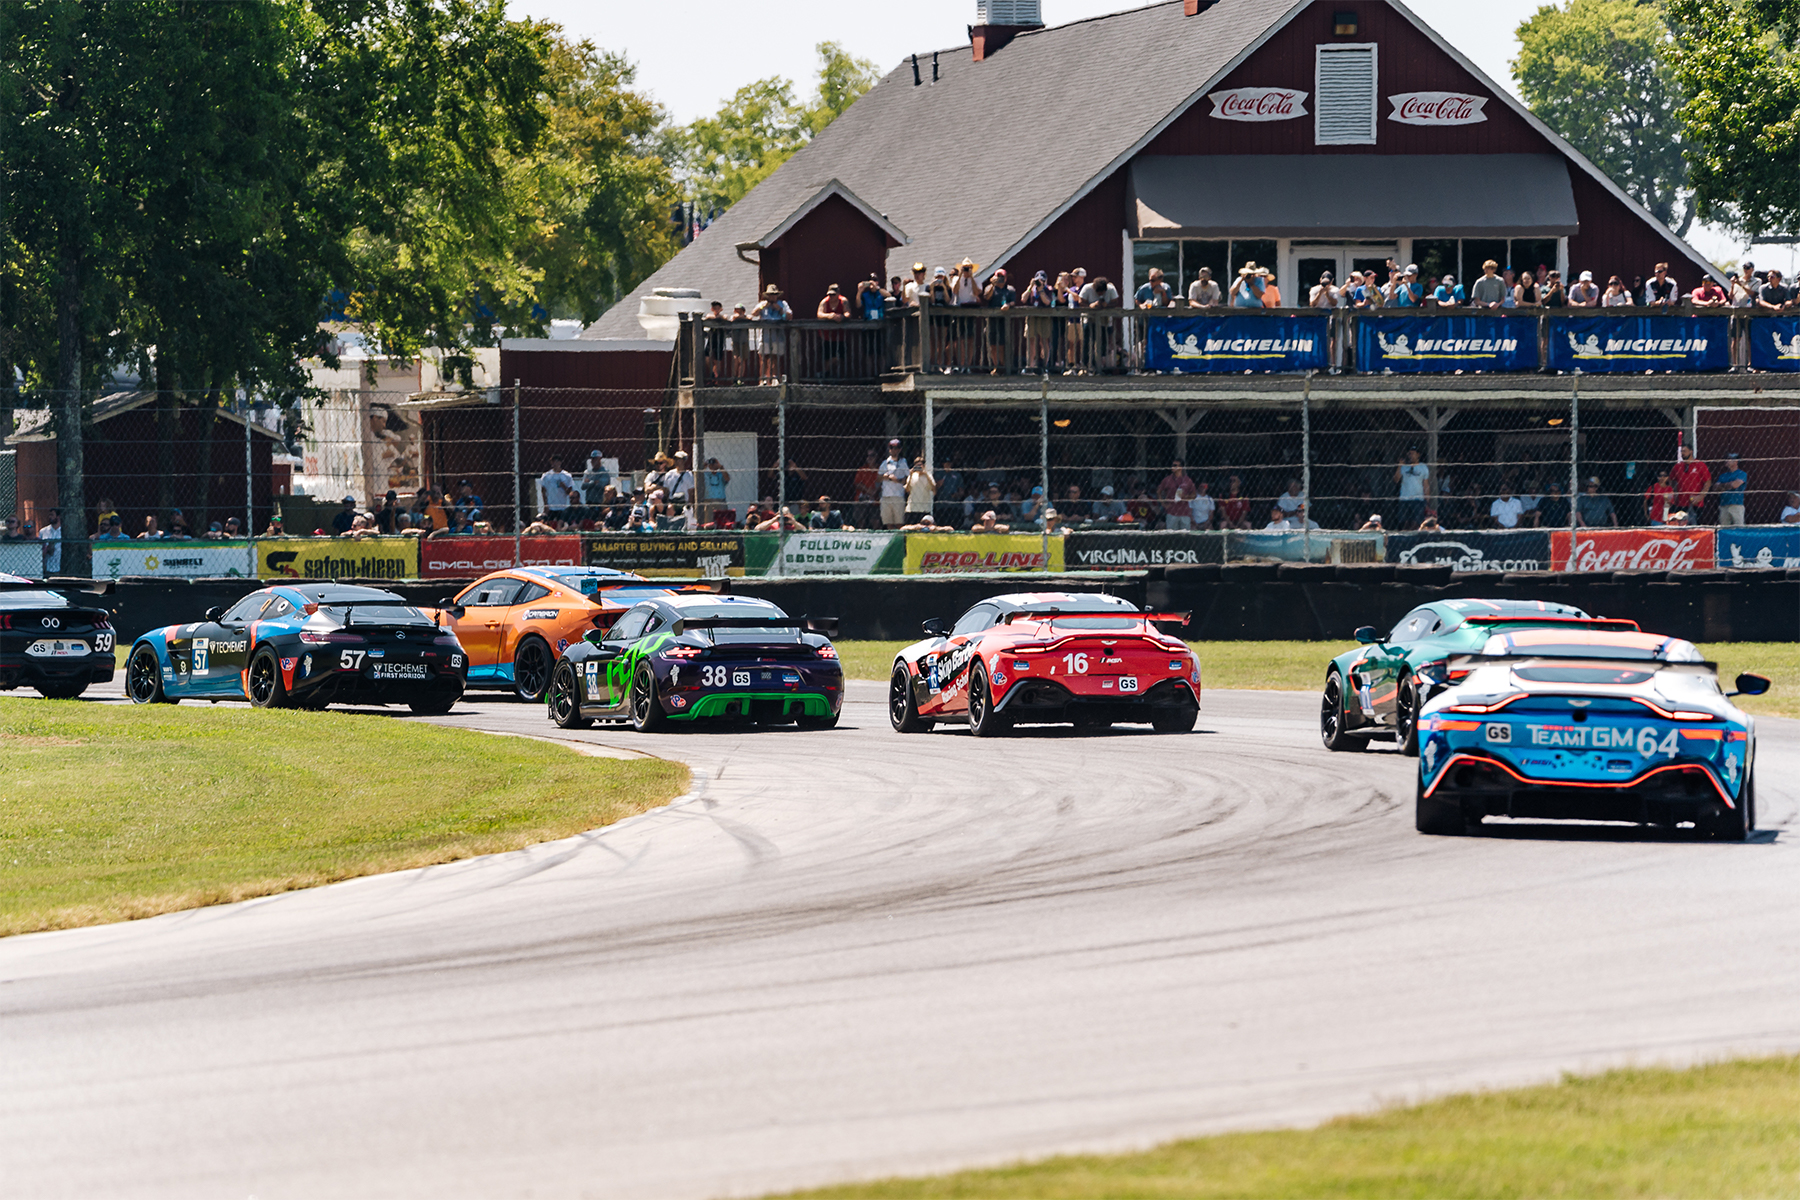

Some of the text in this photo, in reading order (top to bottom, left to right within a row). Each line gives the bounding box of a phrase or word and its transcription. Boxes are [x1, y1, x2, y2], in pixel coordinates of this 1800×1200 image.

[1221, 93, 1295, 115] Coca-Cola
[1400, 96, 1475, 119] Coca-Cola
[1204, 339, 1313, 352] MICHELIN
[1414, 339, 1518, 352] MICHELIN
[1604, 338, 1708, 352] MICHELIN
[592, 540, 738, 552] SMARTER BUYING AND SELLING
[800, 540, 872, 550] FOLLOW US
[697, 554, 732, 568] AWESOME
[921, 551, 1052, 567] PRO-LINE
[1076, 549, 1200, 564] VIRGINIA IS FOR
[1565, 538, 1700, 571] Coca-Cola
[33, 644, 46, 652] GS
[94, 633, 113, 652] 59
[216, 640, 248, 654] TECHEMET
[194, 649, 208, 669] 57
[340, 650, 366, 669] 57
[453, 656, 462, 665] GS
[1062, 652, 1089, 674] 16
[384, 663, 428, 673] TECHEMET
[701, 665, 727, 687] 38
[734, 674, 750, 684] GS
[587, 674, 598, 694] 38
[1121, 679, 1136, 689] GS
[1487, 726, 1510, 740] GS
[1636, 727, 1680, 759] 64
